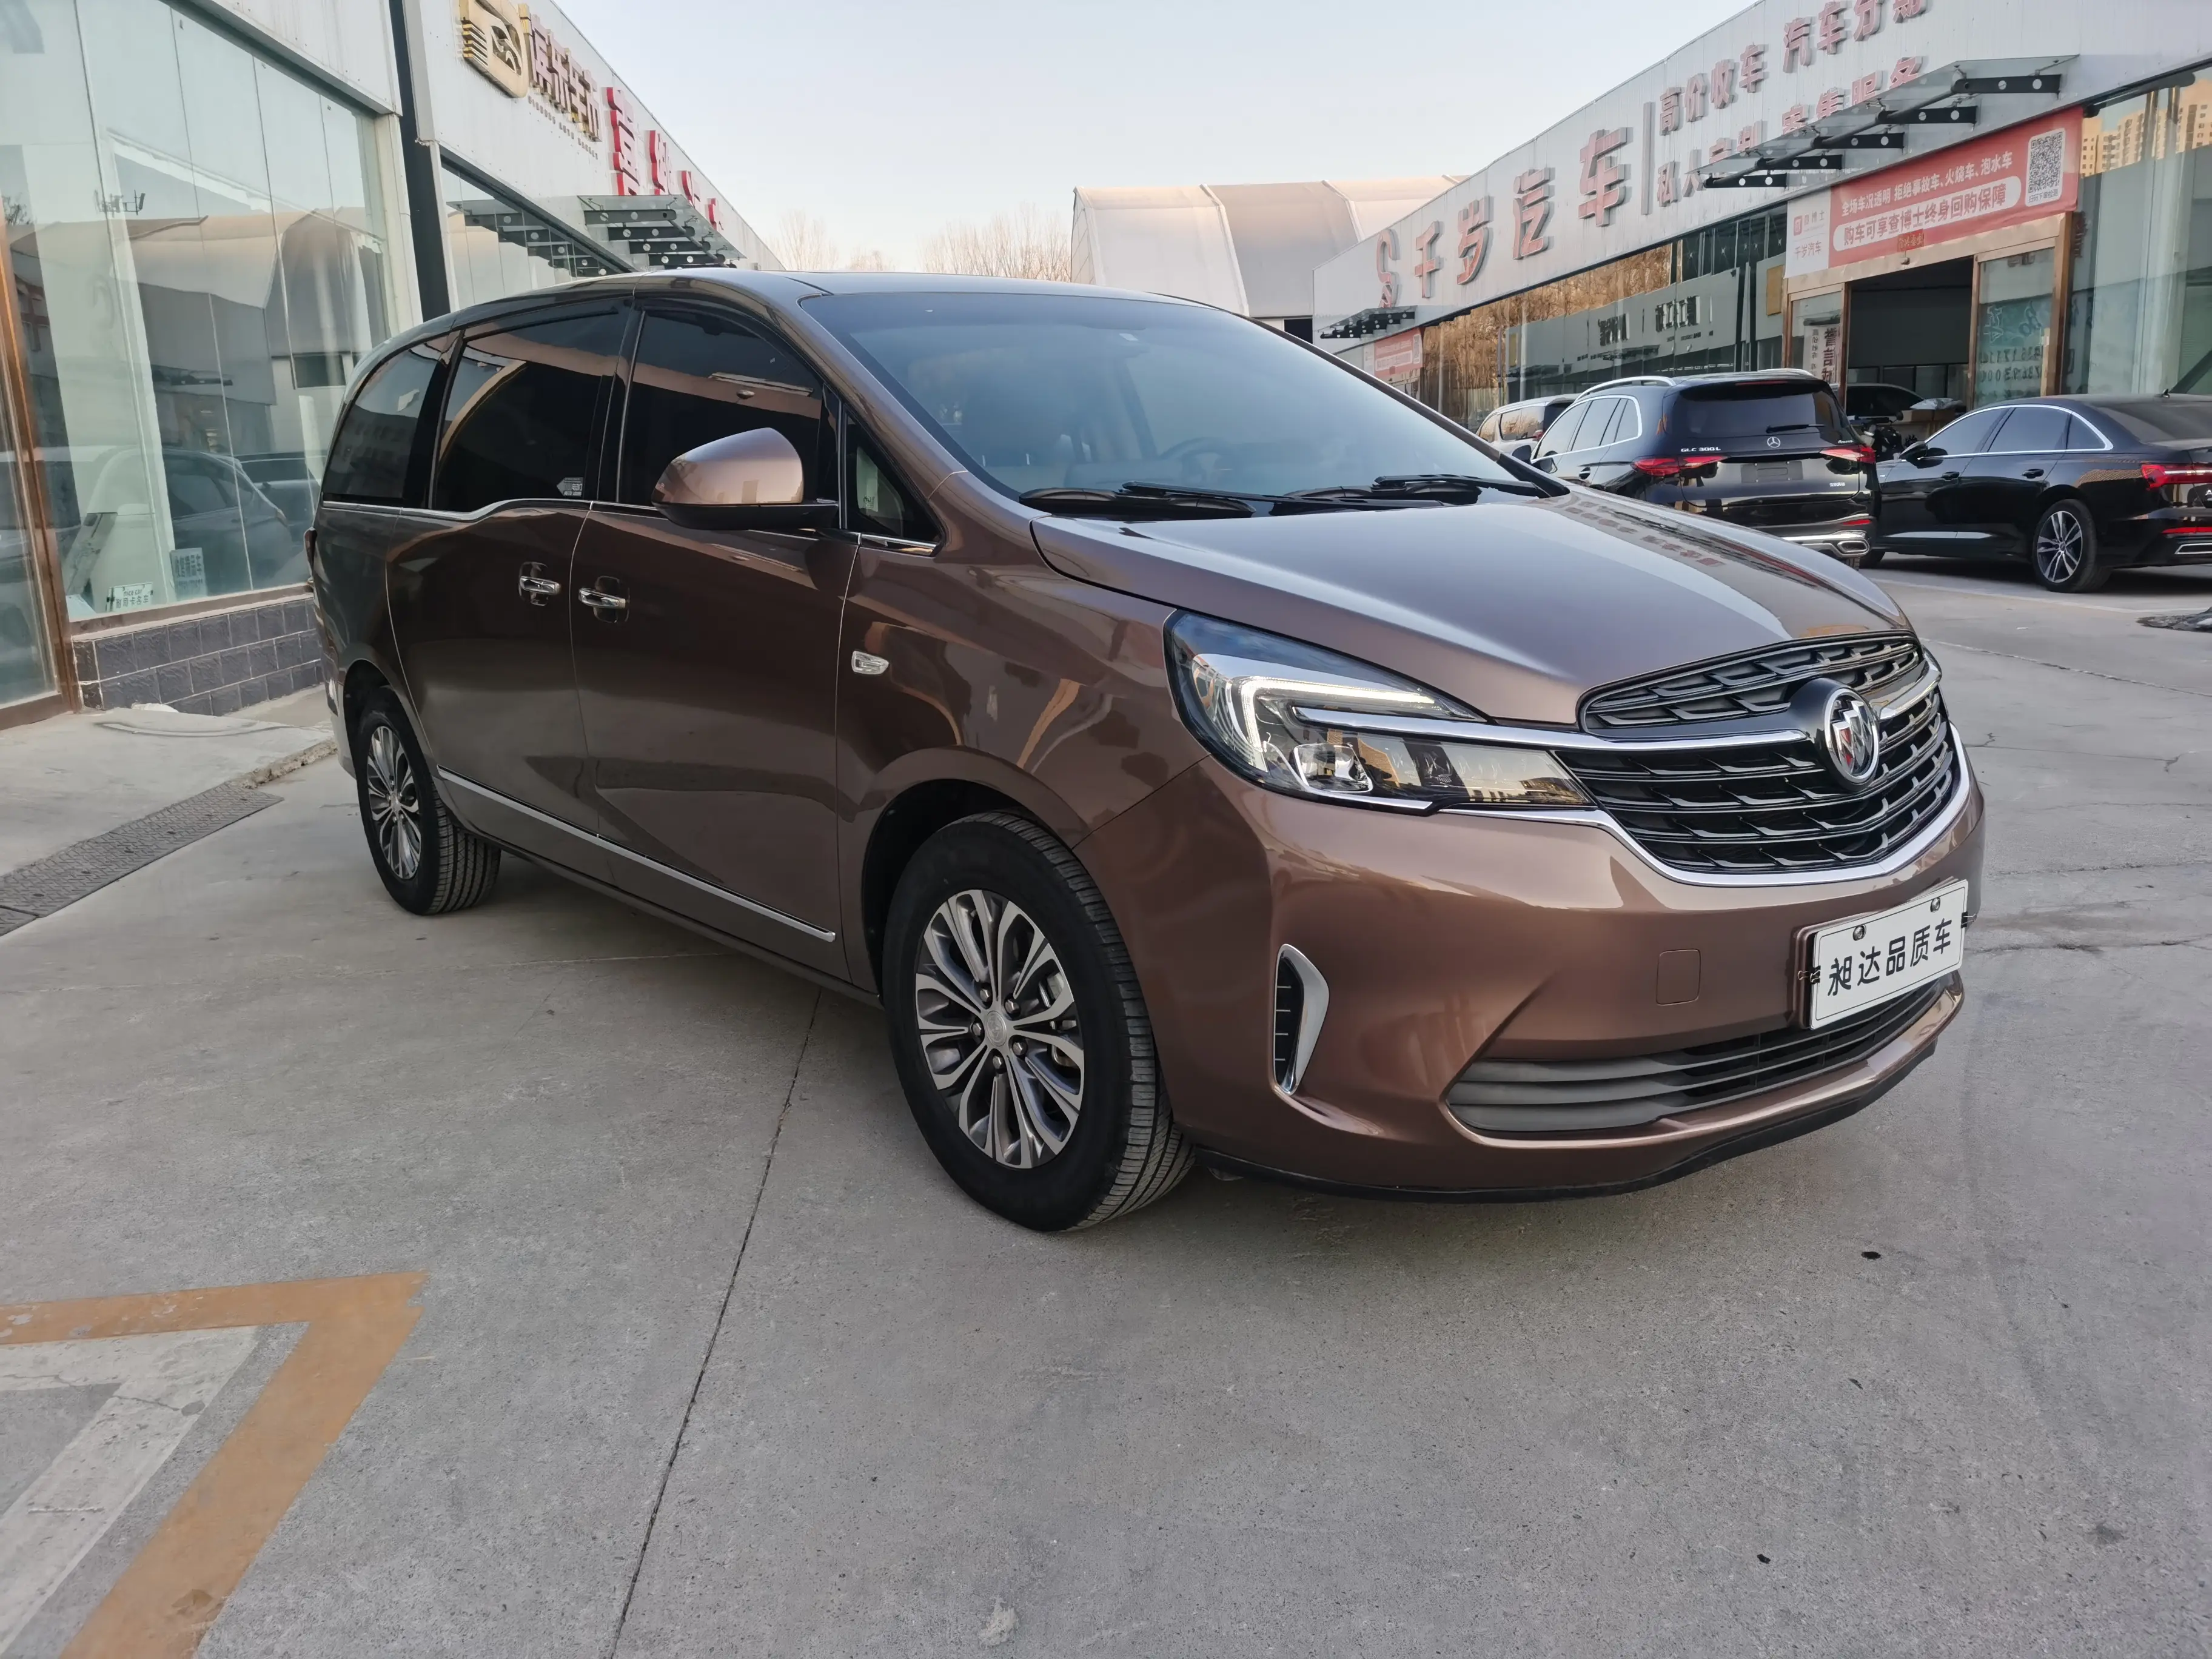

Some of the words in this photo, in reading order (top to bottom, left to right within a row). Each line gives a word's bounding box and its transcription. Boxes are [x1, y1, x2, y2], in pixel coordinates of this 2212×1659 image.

[1659, 42, 1763, 135] 高价收车
[1841, 187, 1891, 217] 全场车况透明
[1843, 183, 2006, 246] 购车可享查博士终身回购保障
[1827, 917, 1952, 996] 昶达品质车
